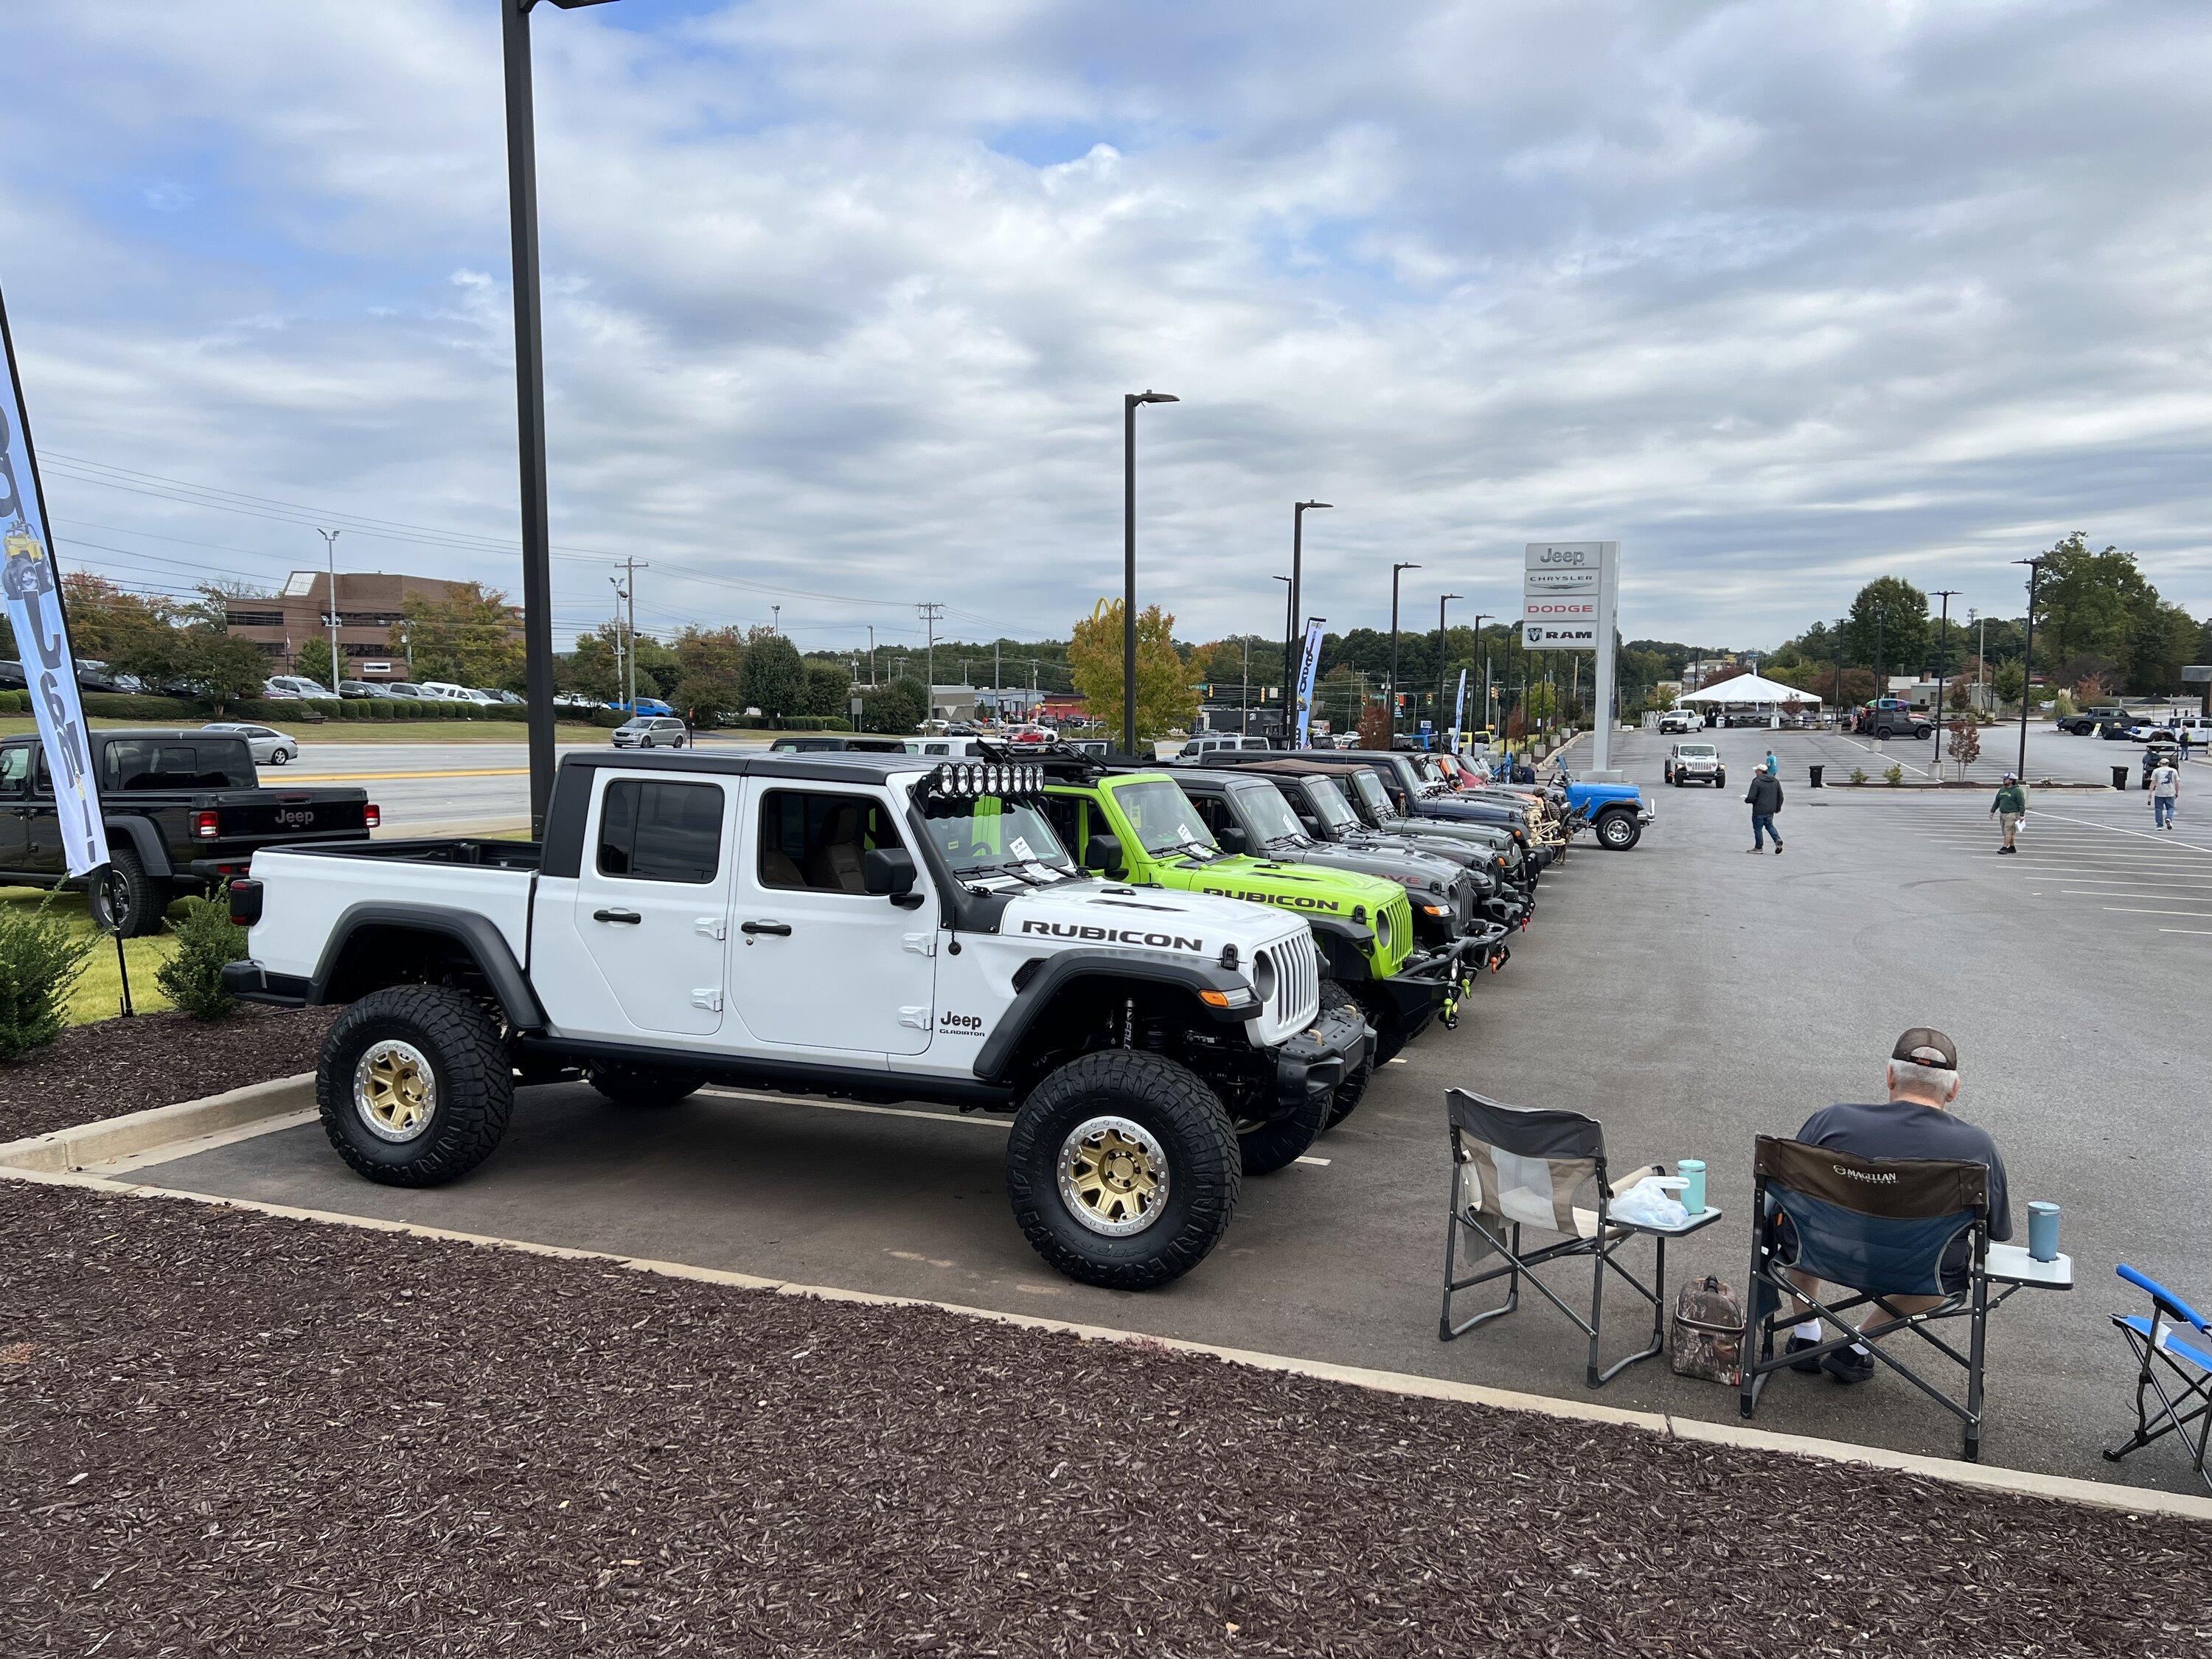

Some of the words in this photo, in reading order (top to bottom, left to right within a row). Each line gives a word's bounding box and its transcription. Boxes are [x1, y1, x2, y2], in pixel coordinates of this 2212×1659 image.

[1540, 548, 1585, 566] Jeep
[1528, 605, 1593, 613] DODGE
[275, 809, 315, 825] Jeep
[1203, 887, 1339, 911] RUBICON
[1021, 919, 1203, 952] RUBICON
[940, 1011, 982, 1030] Jeep
[939, 1029, 985, 1037] GLADIATOR
[1847, 1169, 1896, 1181] MAGELLAN
